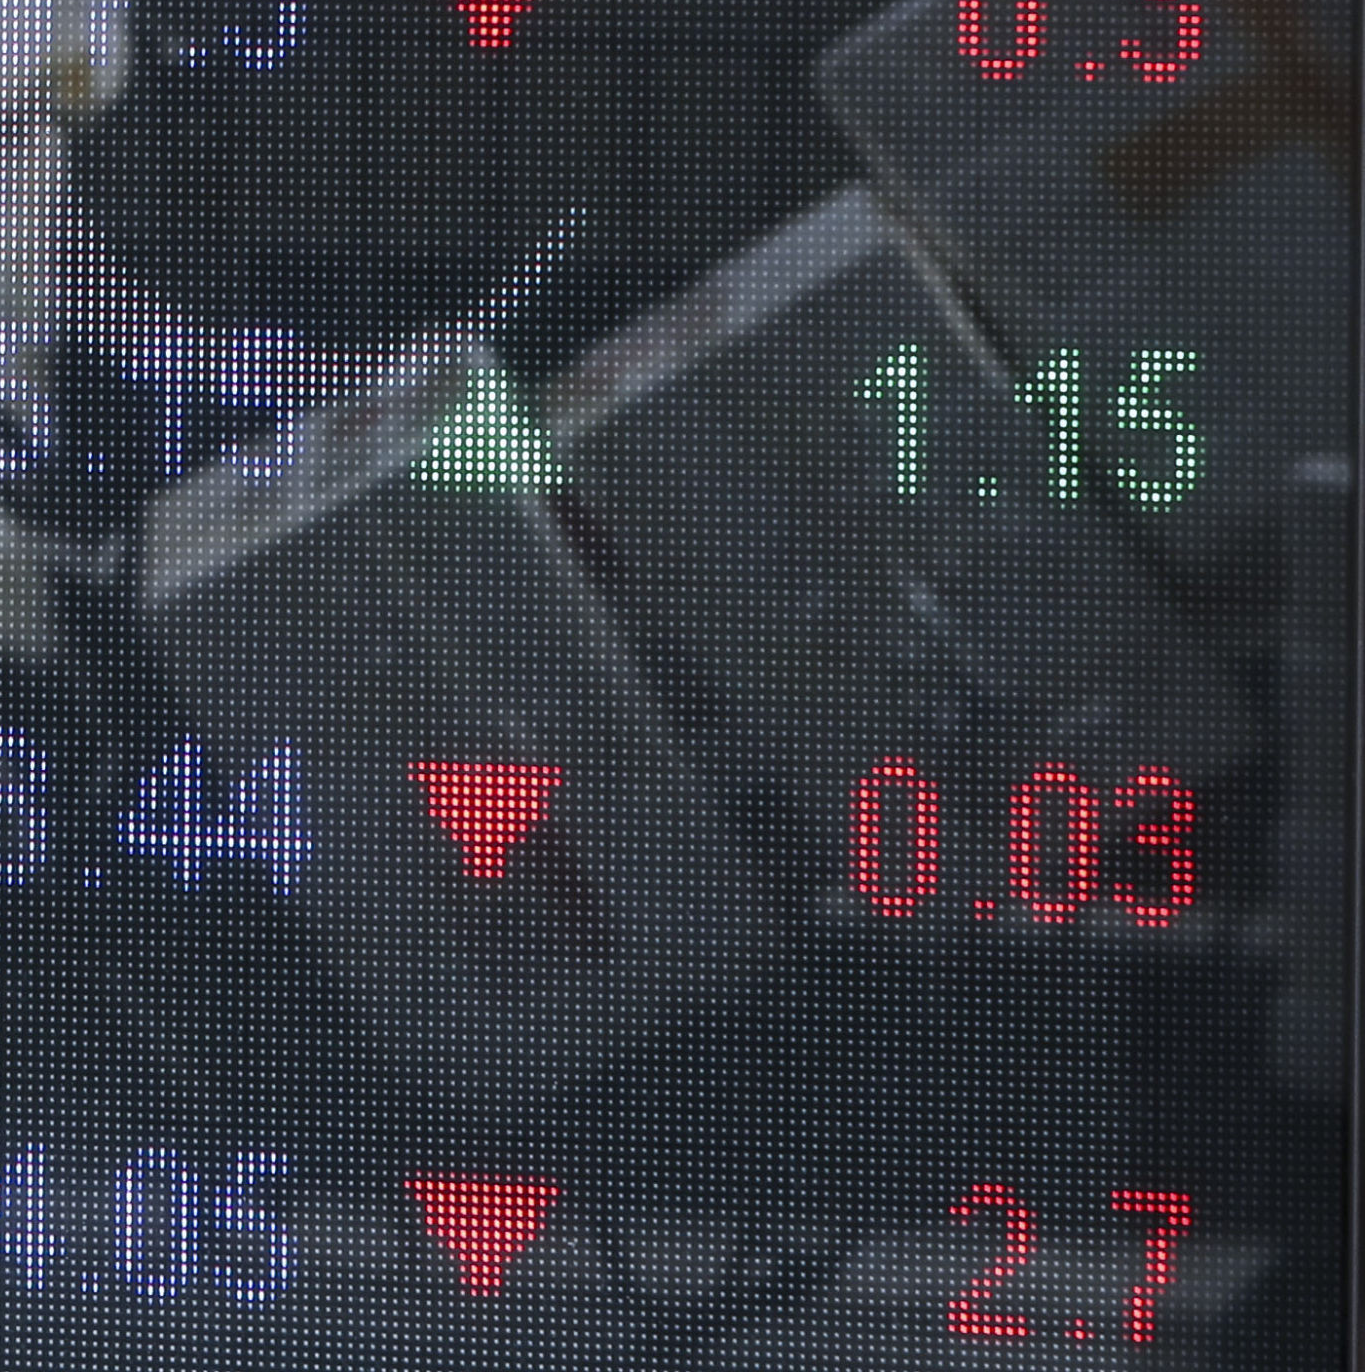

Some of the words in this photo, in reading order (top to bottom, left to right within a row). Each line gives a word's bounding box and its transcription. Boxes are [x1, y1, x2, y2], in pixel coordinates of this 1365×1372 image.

[850, 340, 1204, 510] 1.15
[848, 758, 1196, 926] 0.03
[948, 1184, 1194, 1344] 2.7
